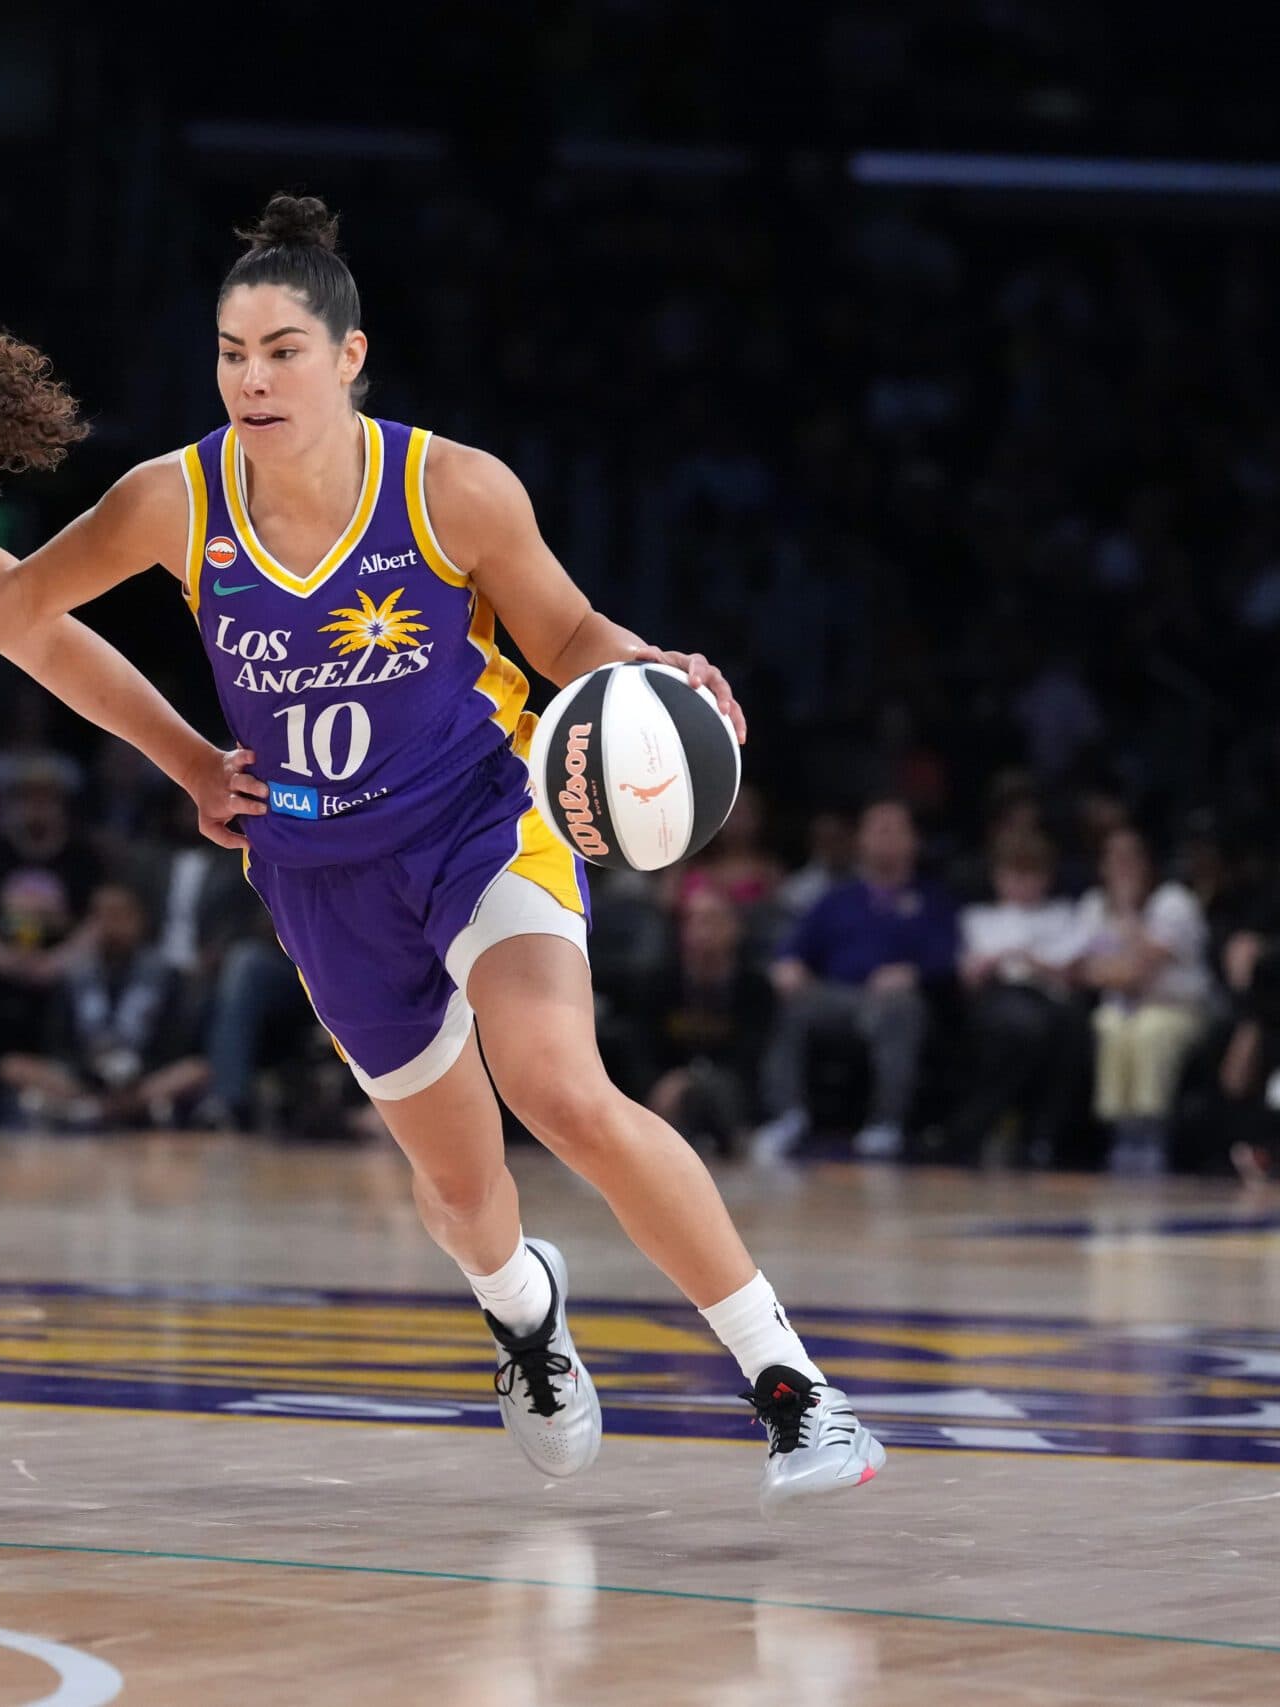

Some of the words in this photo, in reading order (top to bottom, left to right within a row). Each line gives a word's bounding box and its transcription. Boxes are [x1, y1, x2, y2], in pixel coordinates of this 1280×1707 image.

[358, 549, 417, 575] Albert
[216, 614, 292, 662] LOS
[233, 642, 434, 693] ANGELES
[272, 701, 371, 780] 10
[272, 791, 311, 812] UCLA
[558, 721, 609, 856] Wilson
